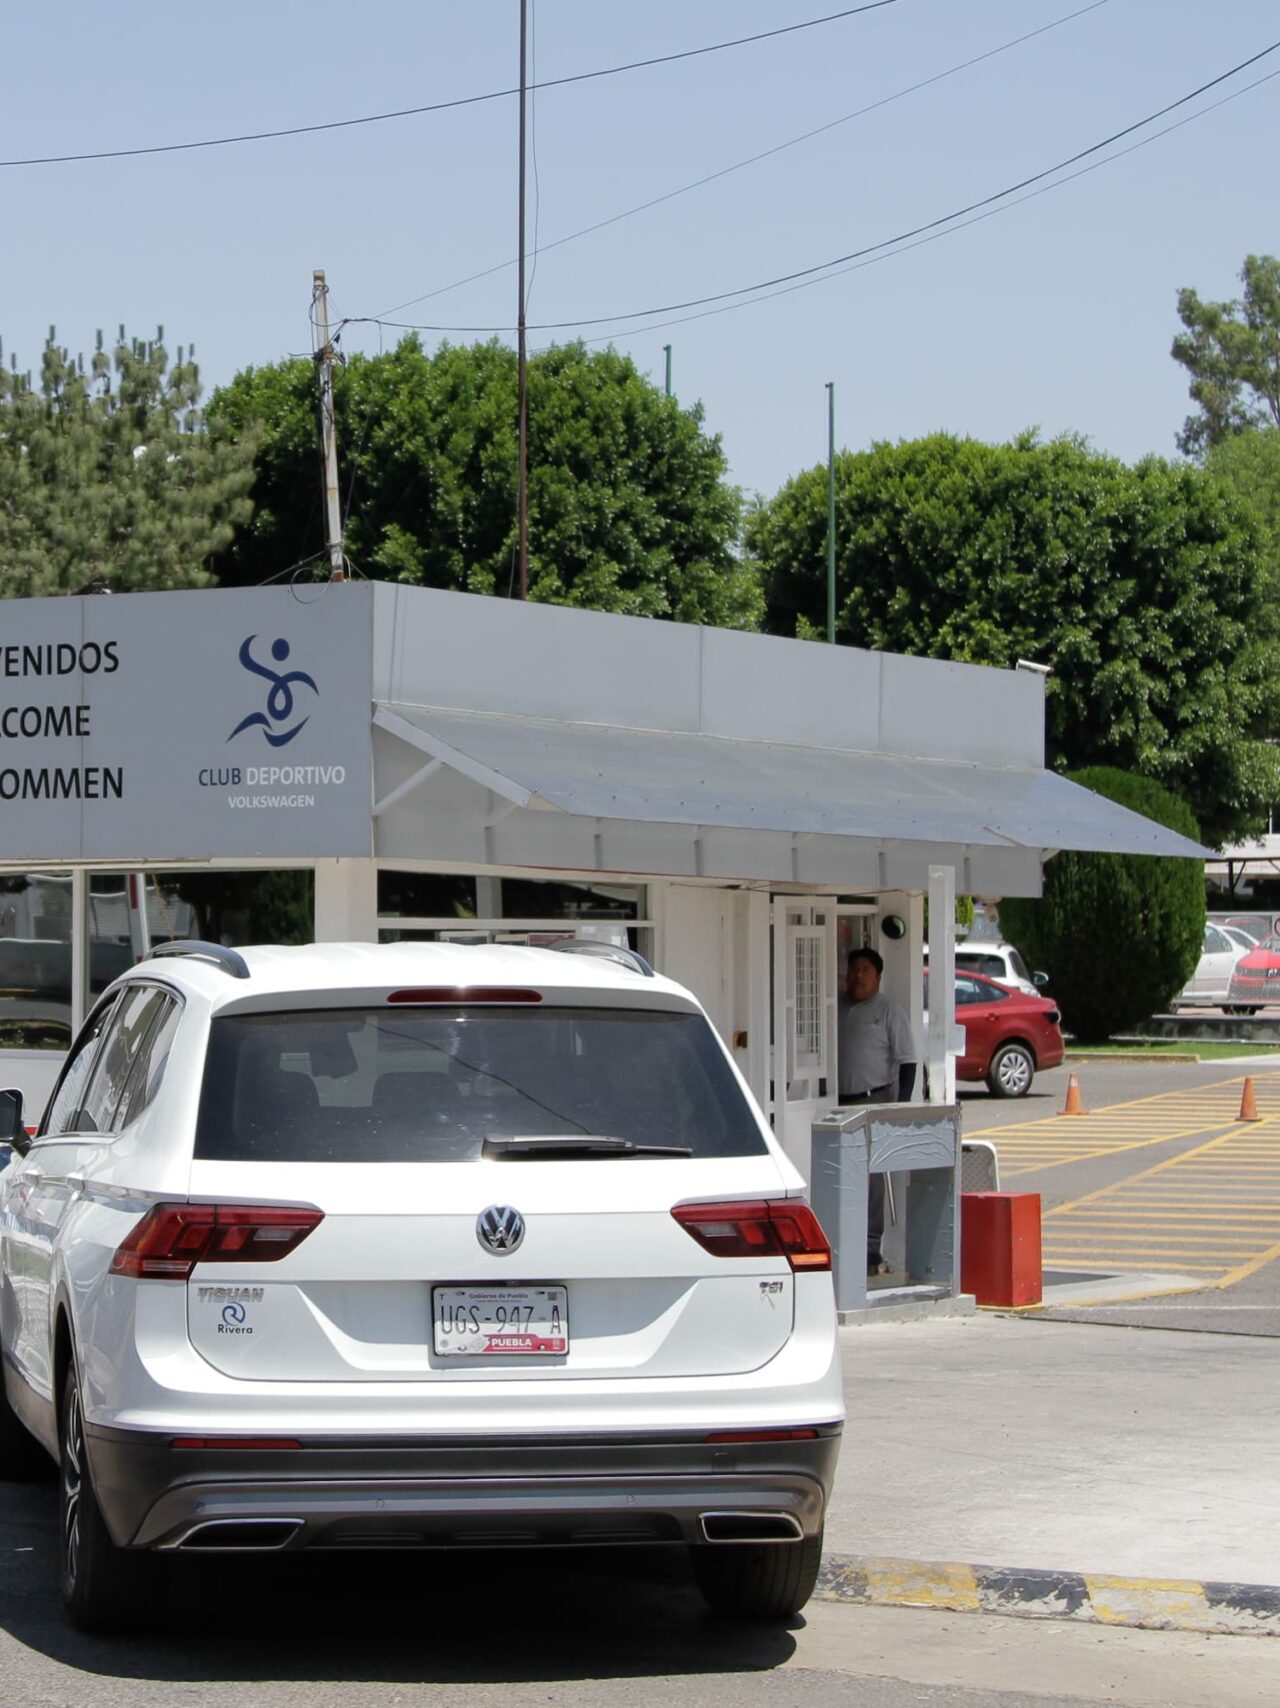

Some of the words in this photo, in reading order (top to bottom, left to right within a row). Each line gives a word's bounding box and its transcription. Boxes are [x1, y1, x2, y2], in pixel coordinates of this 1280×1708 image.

[198, 767, 242, 787] CLUB
[246, 766, 346, 785] DEPORTIVO
[227, 795, 315, 808] VOLKSWAGEN
[476, 1204, 526, 1257] VW
[197, 1287, 265, 1299] TIGUAN
[217, 1323, 253, 1334] Rivera
[491, 1338, 532, 1347] PUEBLA
